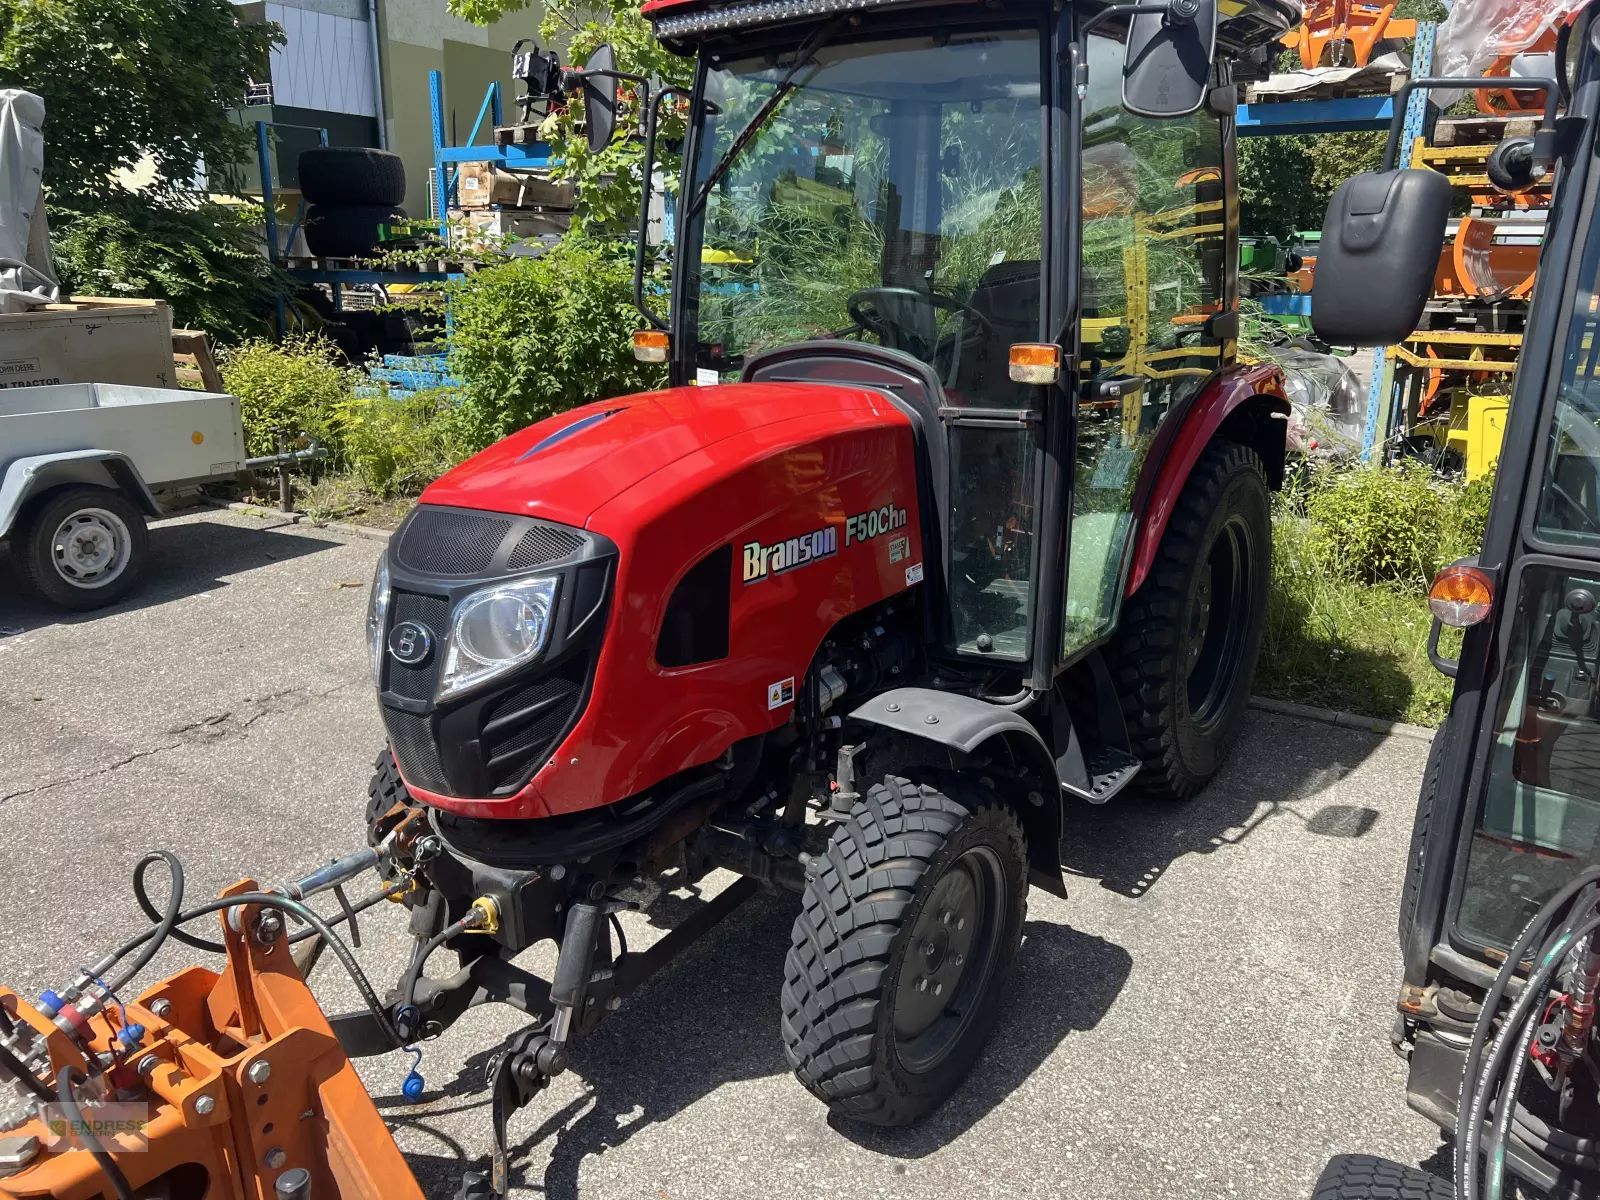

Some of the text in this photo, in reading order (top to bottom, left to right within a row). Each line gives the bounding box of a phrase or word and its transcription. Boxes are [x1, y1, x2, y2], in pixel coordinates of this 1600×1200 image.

[15, 363, 35, 371] DEERE
[11, 378, 60, 388] TRACTOR
[743, 503, 907, 582] Branson F50Chn
